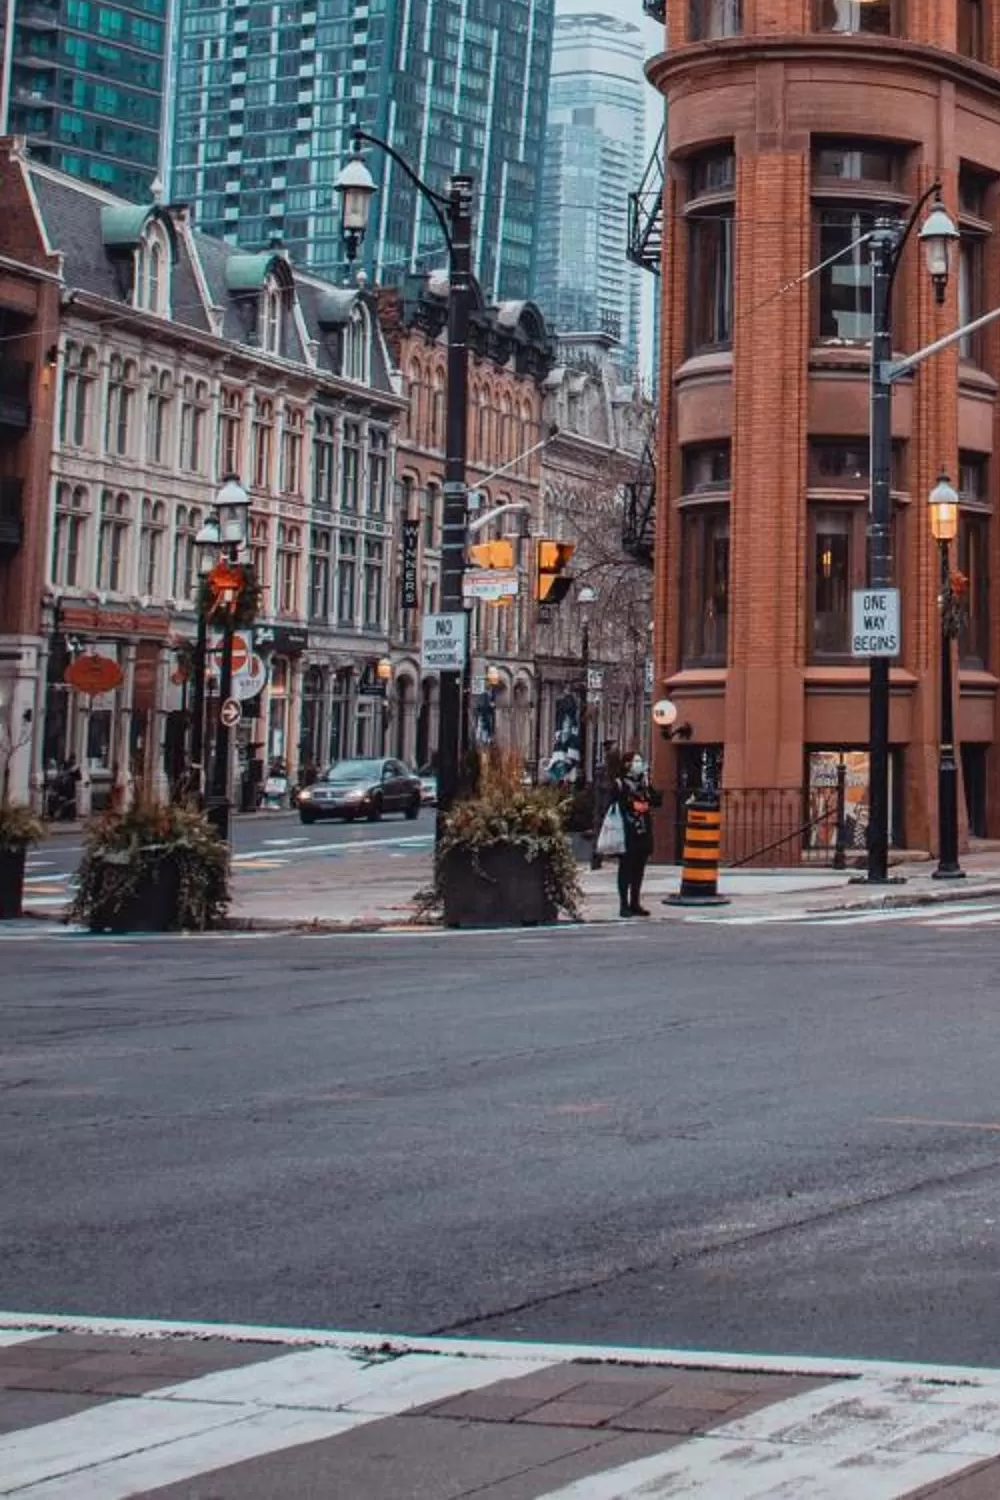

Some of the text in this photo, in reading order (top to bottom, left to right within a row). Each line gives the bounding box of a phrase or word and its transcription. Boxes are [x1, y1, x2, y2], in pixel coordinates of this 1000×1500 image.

[404, 525, 417, 603] WINNERS
[863, 595, 887, 611] ONE
[435, 619, 453, 636] NO
[863, 615, 887, 631] WAY
[853, 635, 897, 651] BEGINS
